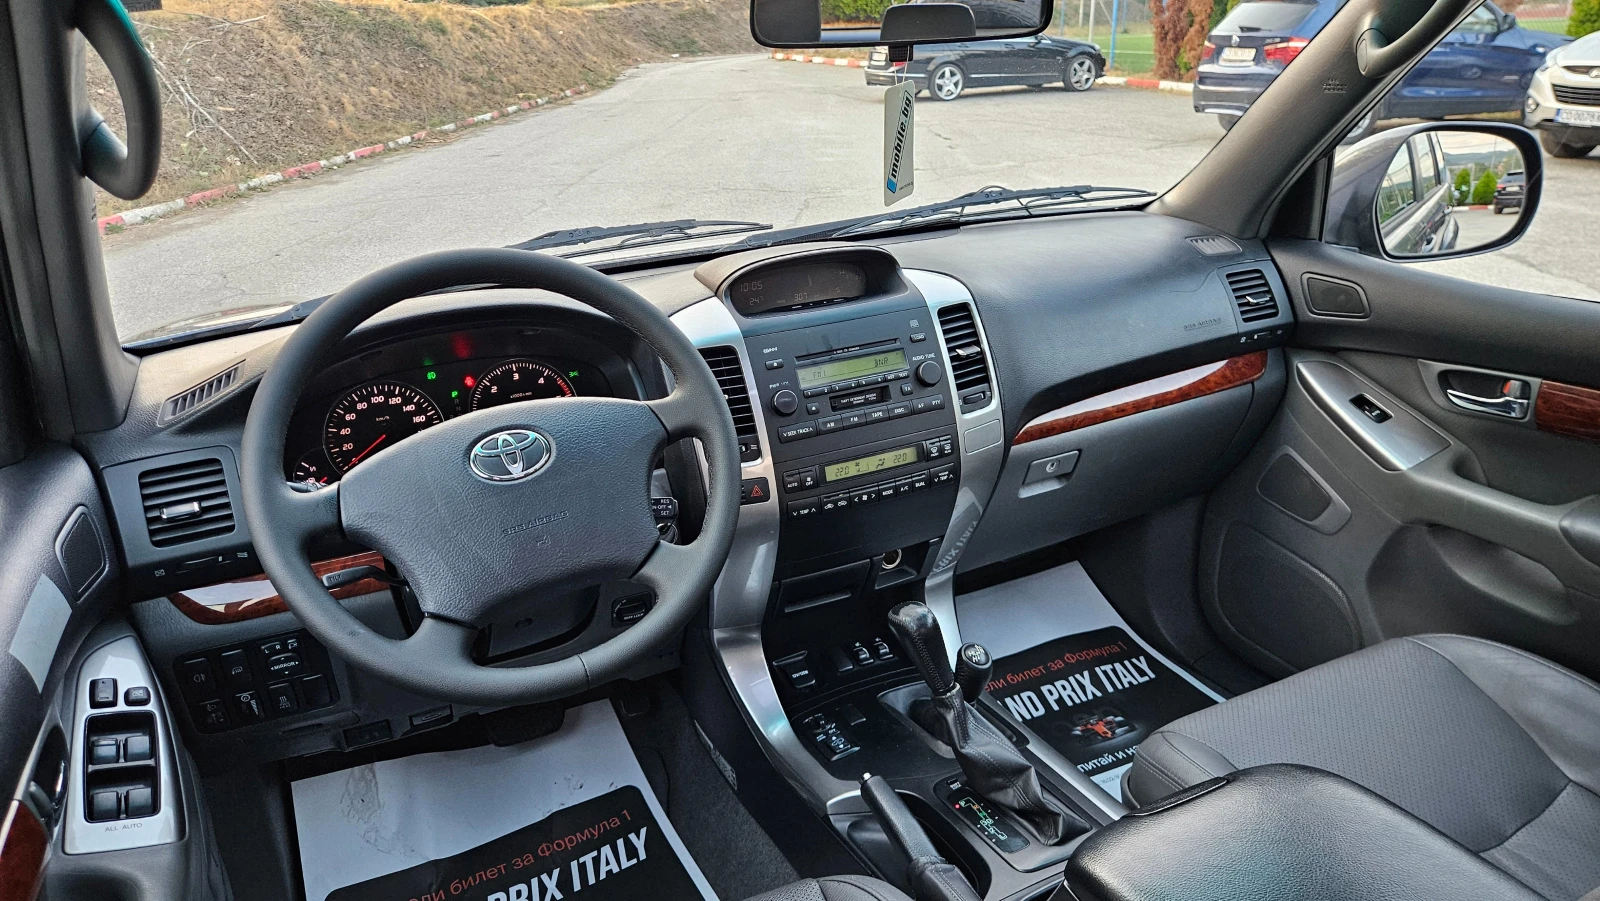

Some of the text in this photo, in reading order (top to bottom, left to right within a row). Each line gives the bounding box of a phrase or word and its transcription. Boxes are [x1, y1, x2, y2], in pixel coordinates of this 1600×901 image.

[890, 96, 912, 179] mobile.bg
[490, 385, 498, 393] 2
[370, 395, 385, 404] 100
[388, 396, 402, 405] 120
[356, 402, 368, 410] 80
[402, 404, 416, 412] 140
[345, 413, 356, 421] 60
[412, 415, 426, 423] 160
[340, 427, 351, 435] 40
[342, 442, 354, 451] 20
[273, 661, 296, 670] MIRROR
[1006, 664, 1046, 686] билет
[1047, 658, 1065, 672] за
[1063, 644, 1120, 666] Формула
[1117, 640, 1128, 652] 1
[998, 654, 1156, 723] ND PRIX ITALY
[1114, 750, 1127, 760] и
[122, 822, 143, 831] AUTO
[449, 863, 507, 896] билет
[511, 852, 535, 870] за
[537, 814, 621, 859] Формула
[620, 809, 633, 824] 1
[570, 826, 650, 893] ITALY
